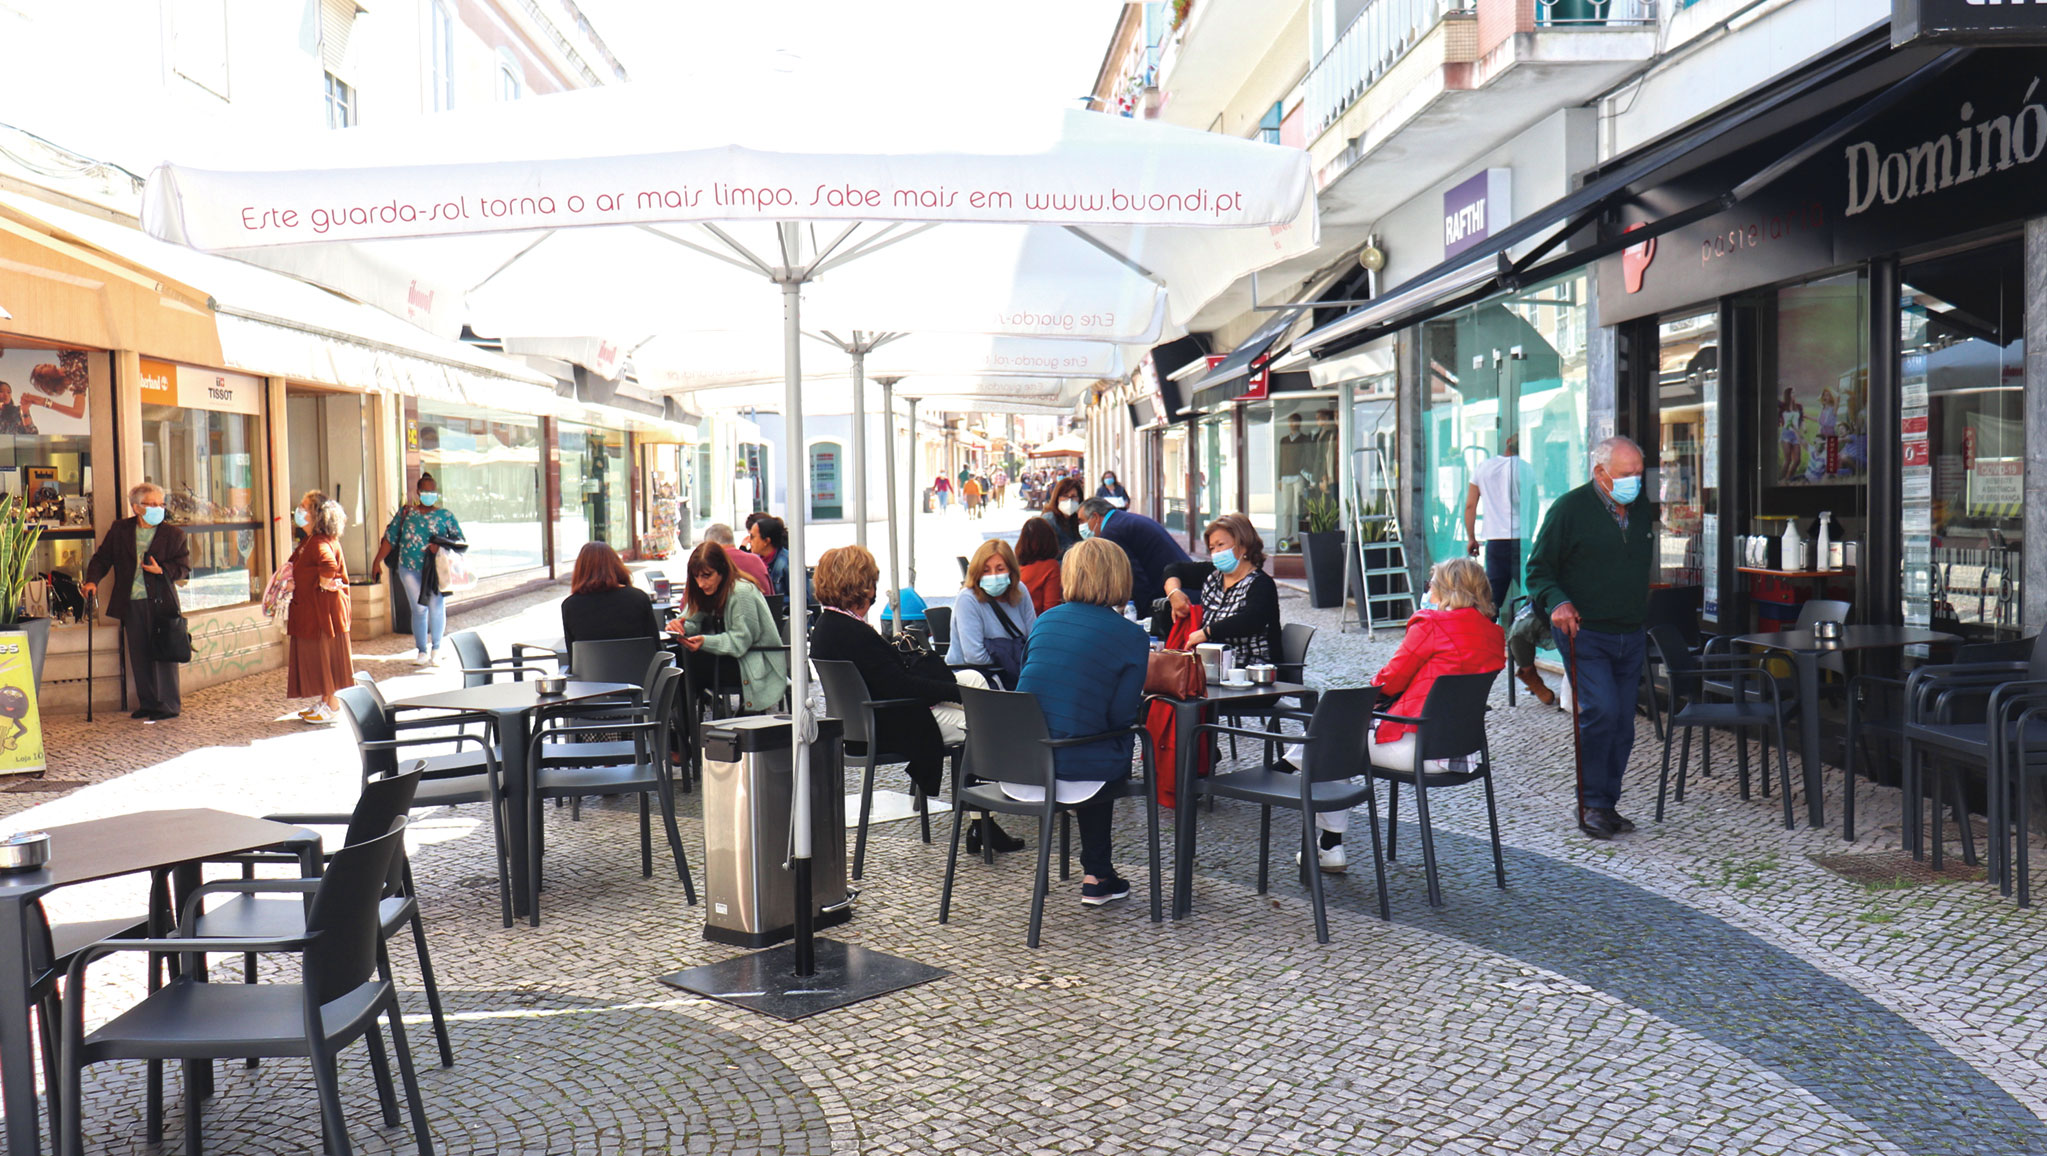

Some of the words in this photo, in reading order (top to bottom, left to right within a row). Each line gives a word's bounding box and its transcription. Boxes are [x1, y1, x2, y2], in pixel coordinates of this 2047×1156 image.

[1845, 75, 2047, 217] Dominó
[241, 206, 299, 230] Este
[311, 199, 470, 234] guarda-sol
[480, 196, 556, 218] torna
[567, 195, 585, 213] o
[596, 193, 625, 212] ar
[637, 185, 703, 209] mais
[714, 182, 799, 213] limpo.
[809, 183, 881, 207] Sabe
[893, 185, 958, 208] mais
[969, 191, 1012, 209] em
[1025, 188, 1242, 217] www.buondi.pt
[1702, 201, 1823, 267] pastelaria
[208, 387, 233, 401] TISSOT
[1981, 464, 2018, 476] COVID-19
